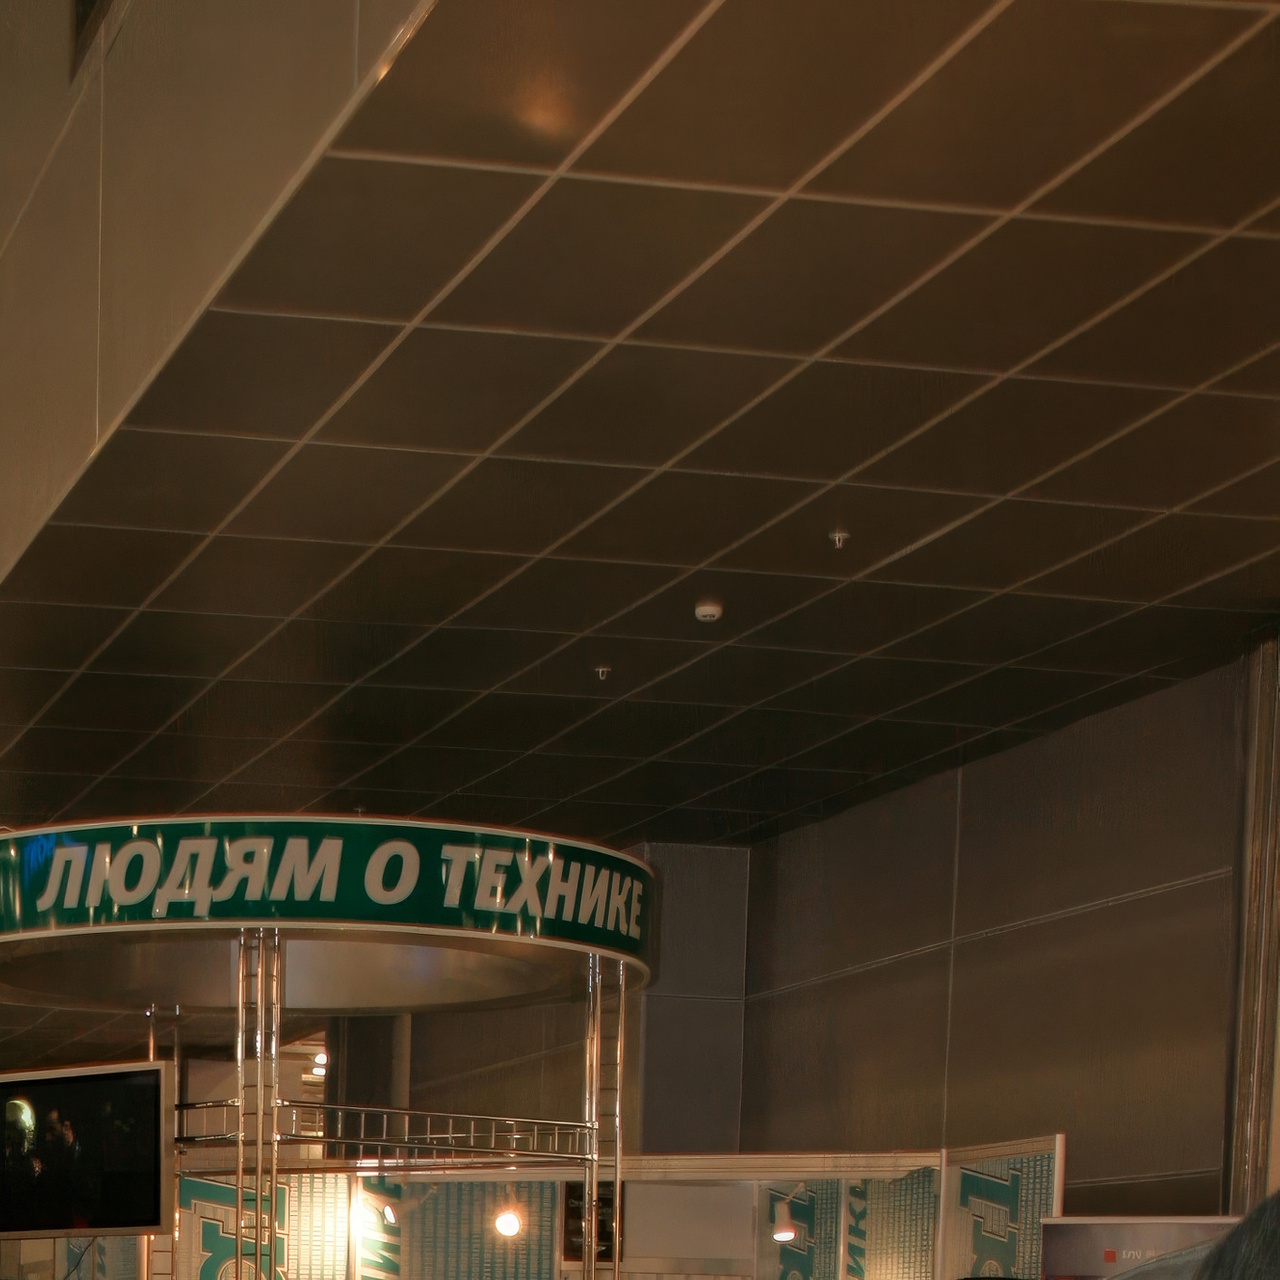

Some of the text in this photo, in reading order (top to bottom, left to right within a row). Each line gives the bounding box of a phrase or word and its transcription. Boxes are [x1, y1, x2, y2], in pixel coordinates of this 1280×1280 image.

[37, 837, 644, 939] ЛЮДЯМ О ТЕХНИКЕ
